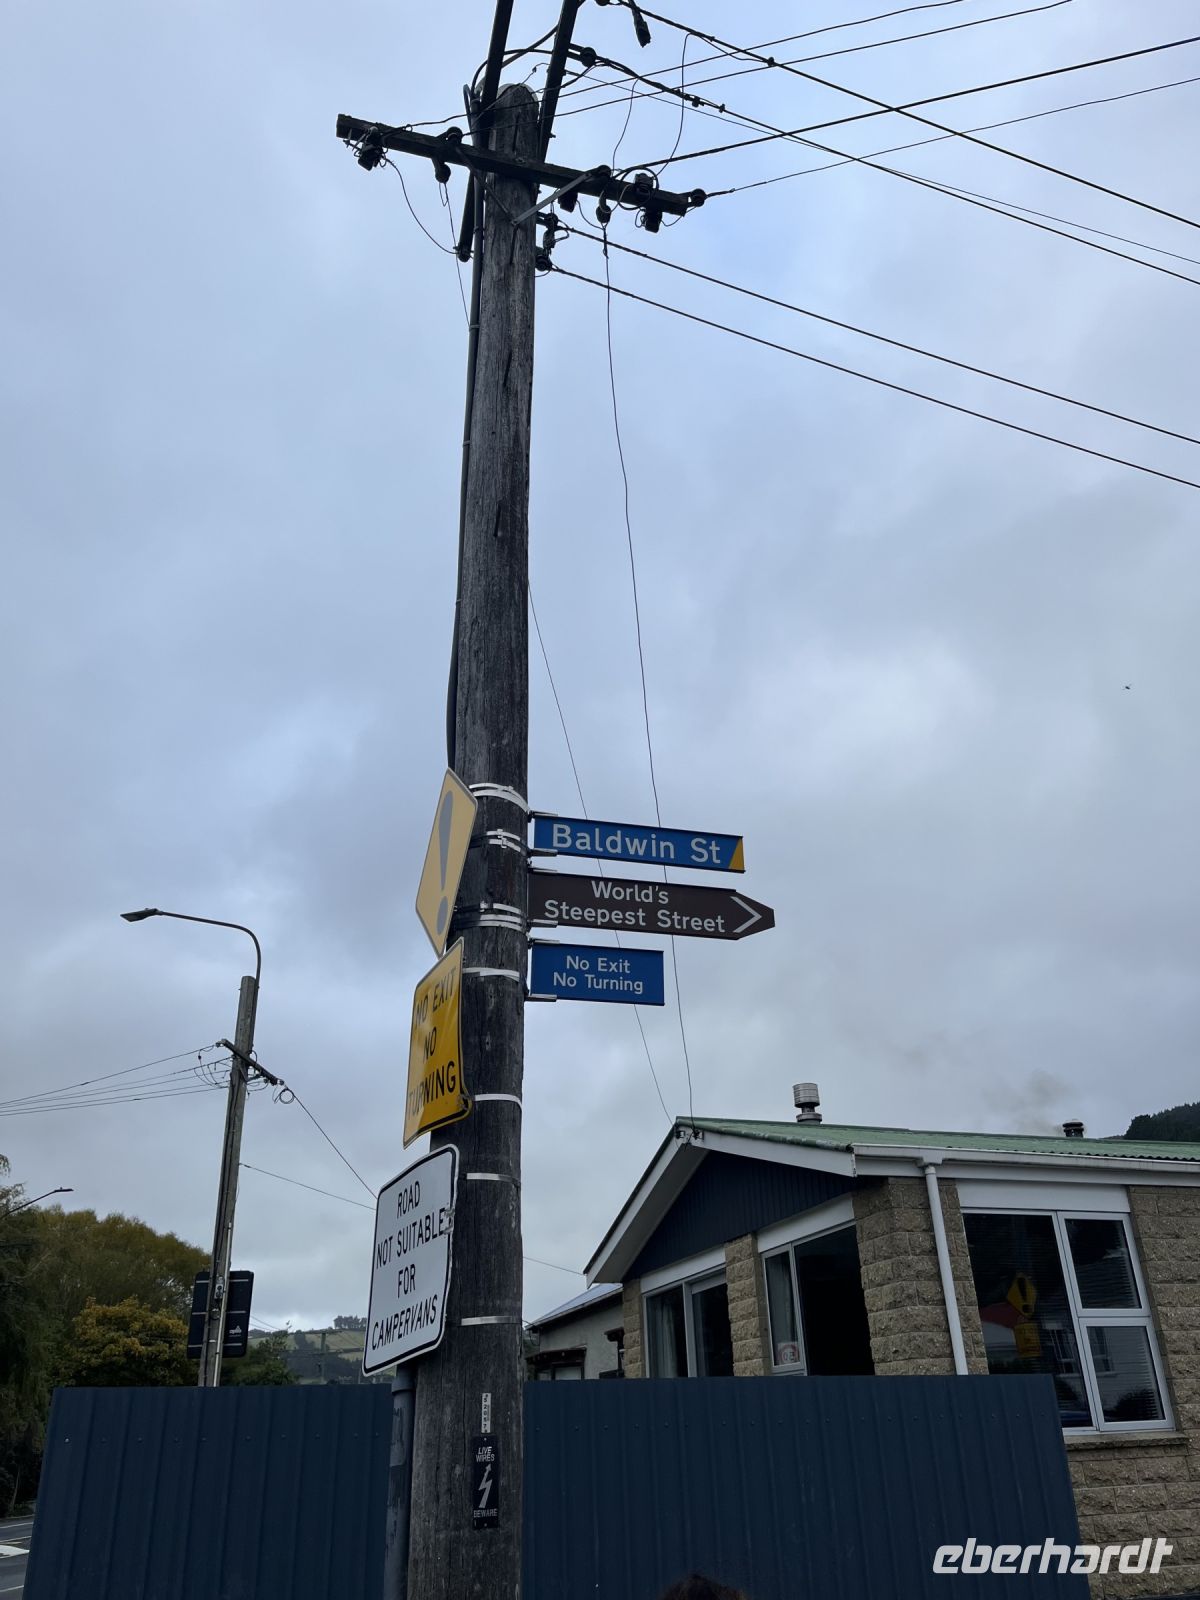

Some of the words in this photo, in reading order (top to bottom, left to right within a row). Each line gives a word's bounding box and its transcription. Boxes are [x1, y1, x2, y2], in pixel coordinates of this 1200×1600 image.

[553, 823, 674, 859] Baldwin
[690, 838, 721, 864] St
[591, 880, 669, 904] World's
[544, 900, 646, 926] Steepest
[657, 910, 725, 933] Street
[566, 956, 589, 971] No
[597, 958, 630, 973] Exit
[415, 994, 428, 1028] NO
[432, 967, 456, 1012] EXIT
[553, 972, 577, 987] No
[584, 974, 643, 994] Turning
[423, 1026, 437, 1064] NO
[409, 1060, 456, 1117] TURNING
[397, 1181, 420, 1219] ROAD
[376, 1236, 393, 1269] NOT
[396, 1207, 445, 1257] SUITABLE
[397, 1264, 416, 1298] FOR
[372, 1294, 438, 1351] CAMPERVANS
[476, 1453, 495, 1462] WIRES
[478, 1446, 493, 1455] LIVE
[473, 1508, 498, 1518] BEWARE
